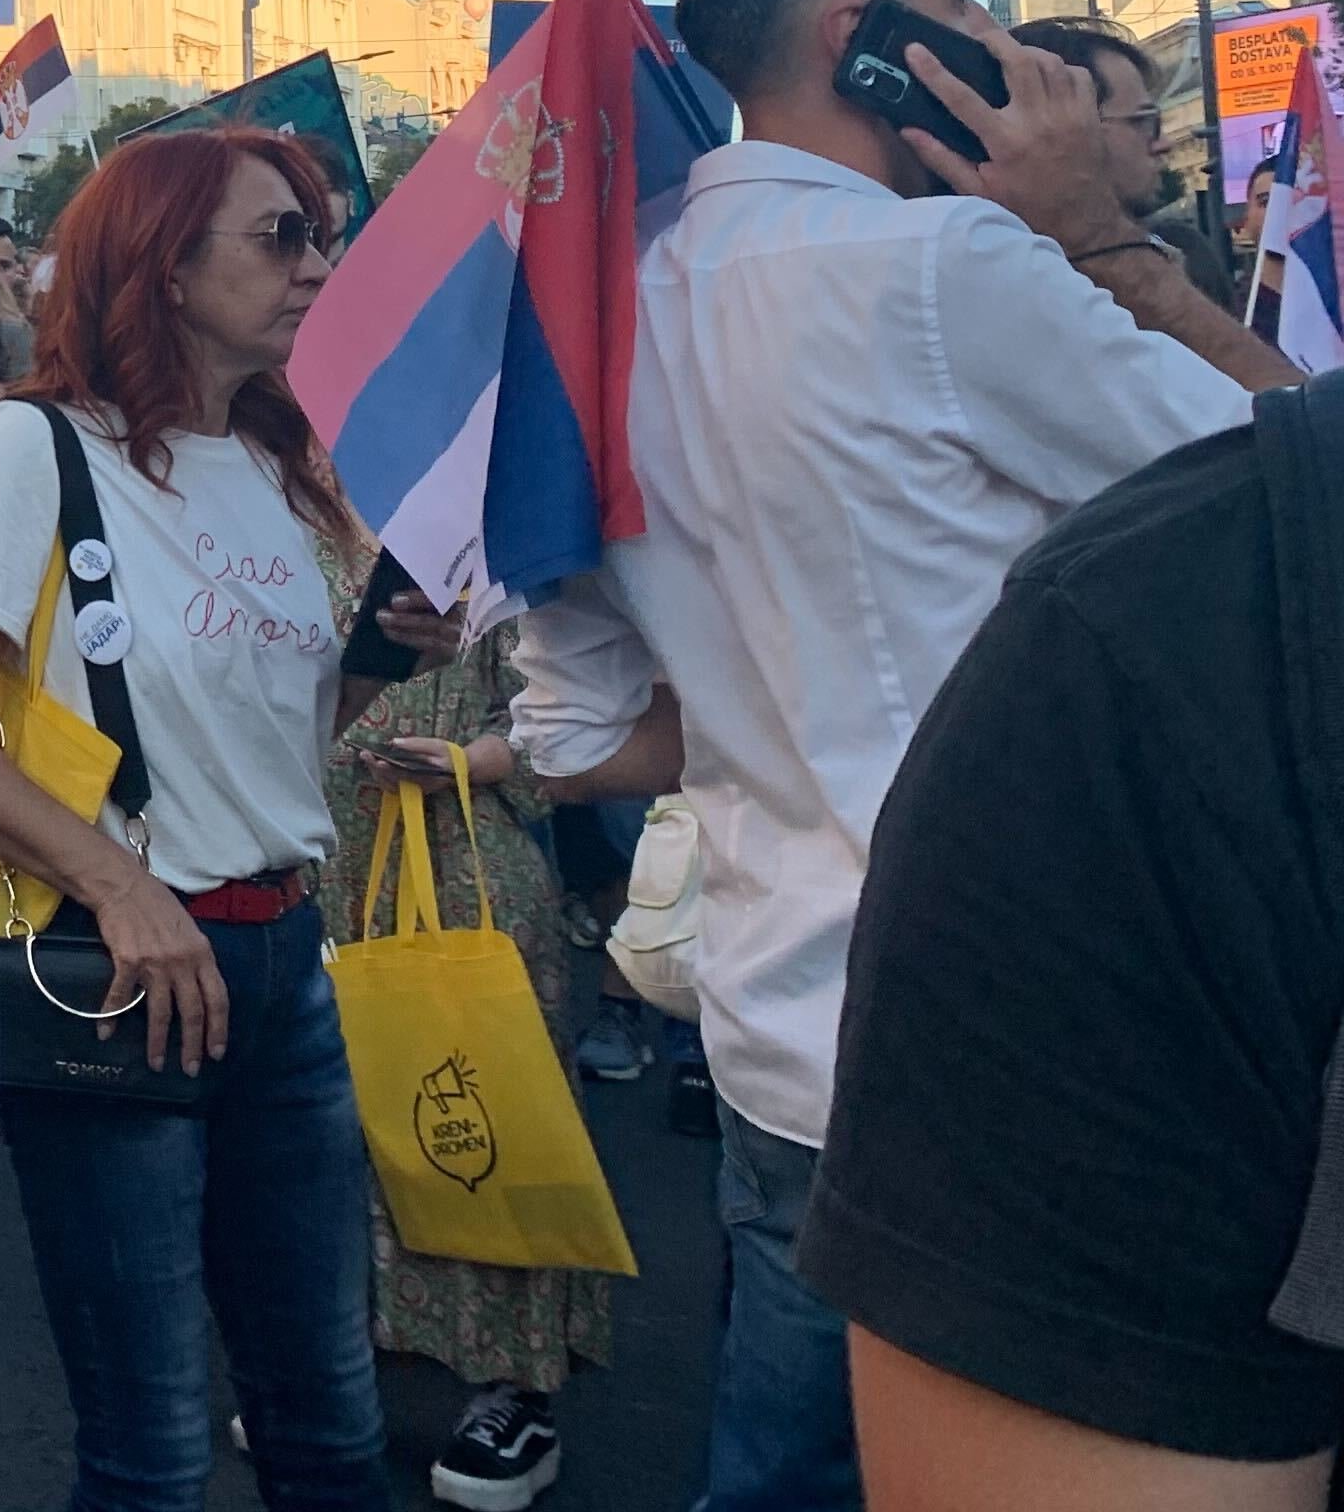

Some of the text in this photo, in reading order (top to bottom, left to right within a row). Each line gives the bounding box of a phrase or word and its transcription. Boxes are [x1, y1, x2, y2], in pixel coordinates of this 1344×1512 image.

[1230, 44, 1291, 64] DOSTAVA
[195, 533, 295, 586] Ciao
[86, 615, 126, 657] ЈАДАР!
[55, 1060, 124, 1081] TOMMY
[432, 1118, 478, 1139] KRENI-
[432, 1134, 487, 1156] PROMENI
